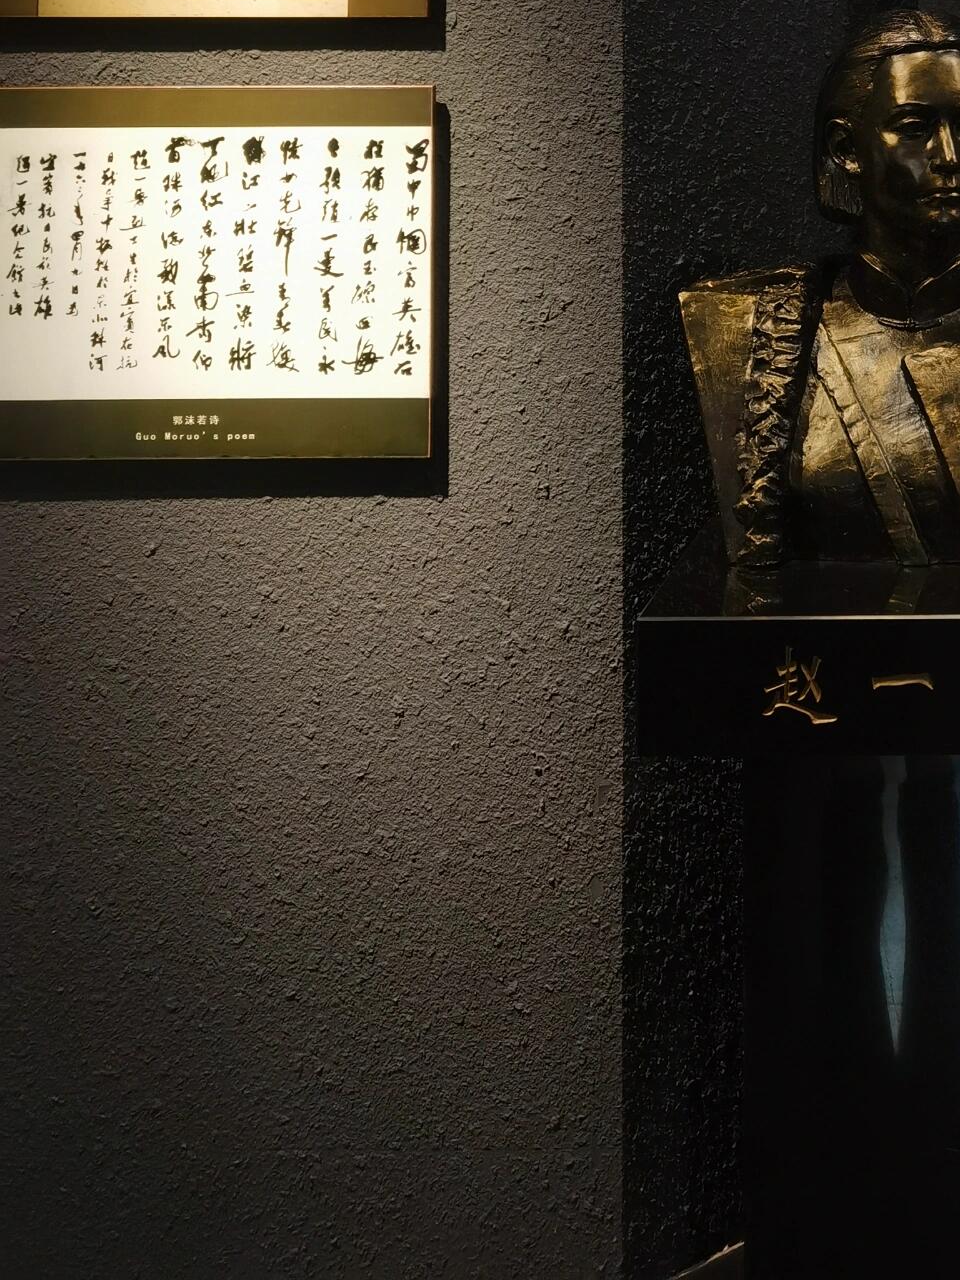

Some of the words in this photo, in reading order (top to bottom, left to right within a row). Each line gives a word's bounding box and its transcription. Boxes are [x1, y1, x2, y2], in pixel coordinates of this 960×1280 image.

[172, 415, 220, 425] 郭沫若诗
[135, 432, 157, 441] Guo
[227, 433, 256, 441] poem
